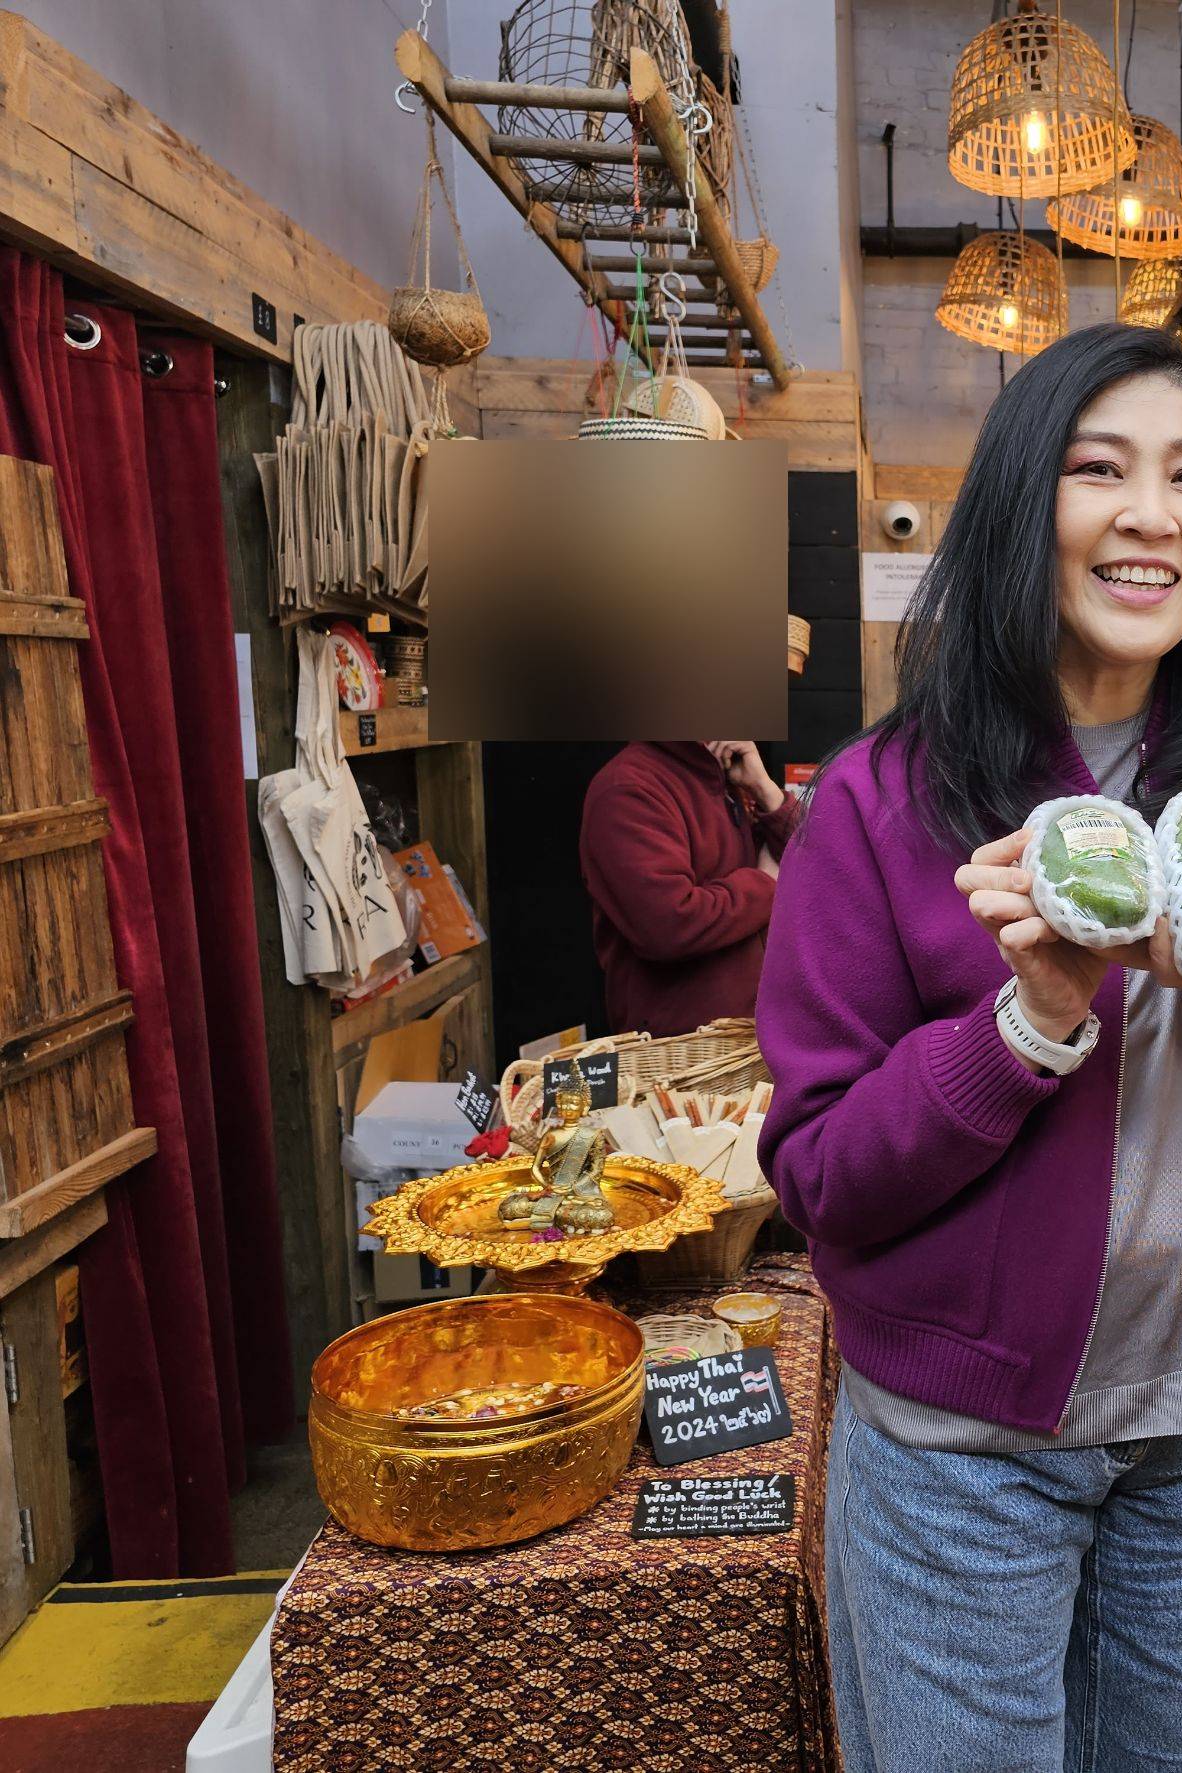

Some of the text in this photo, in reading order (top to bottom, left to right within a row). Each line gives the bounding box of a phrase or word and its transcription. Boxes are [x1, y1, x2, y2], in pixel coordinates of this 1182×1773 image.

[646, 1353, 744, 1392] Happy Thai
[657, 1385, 741, 1418] New Year
[661, 1415, 719, 1444] 2024
[650, 1481, 672, 1491] To
[643, 1488, 782, 1504] Wish Good Luck
[663, 1500, 786, 1514] by binding people's wrist
[662, 1516, 674, 1524] by
[680, 1513, 718, 1523] bathing
[739, 1512, 780, 1520] Buddha
